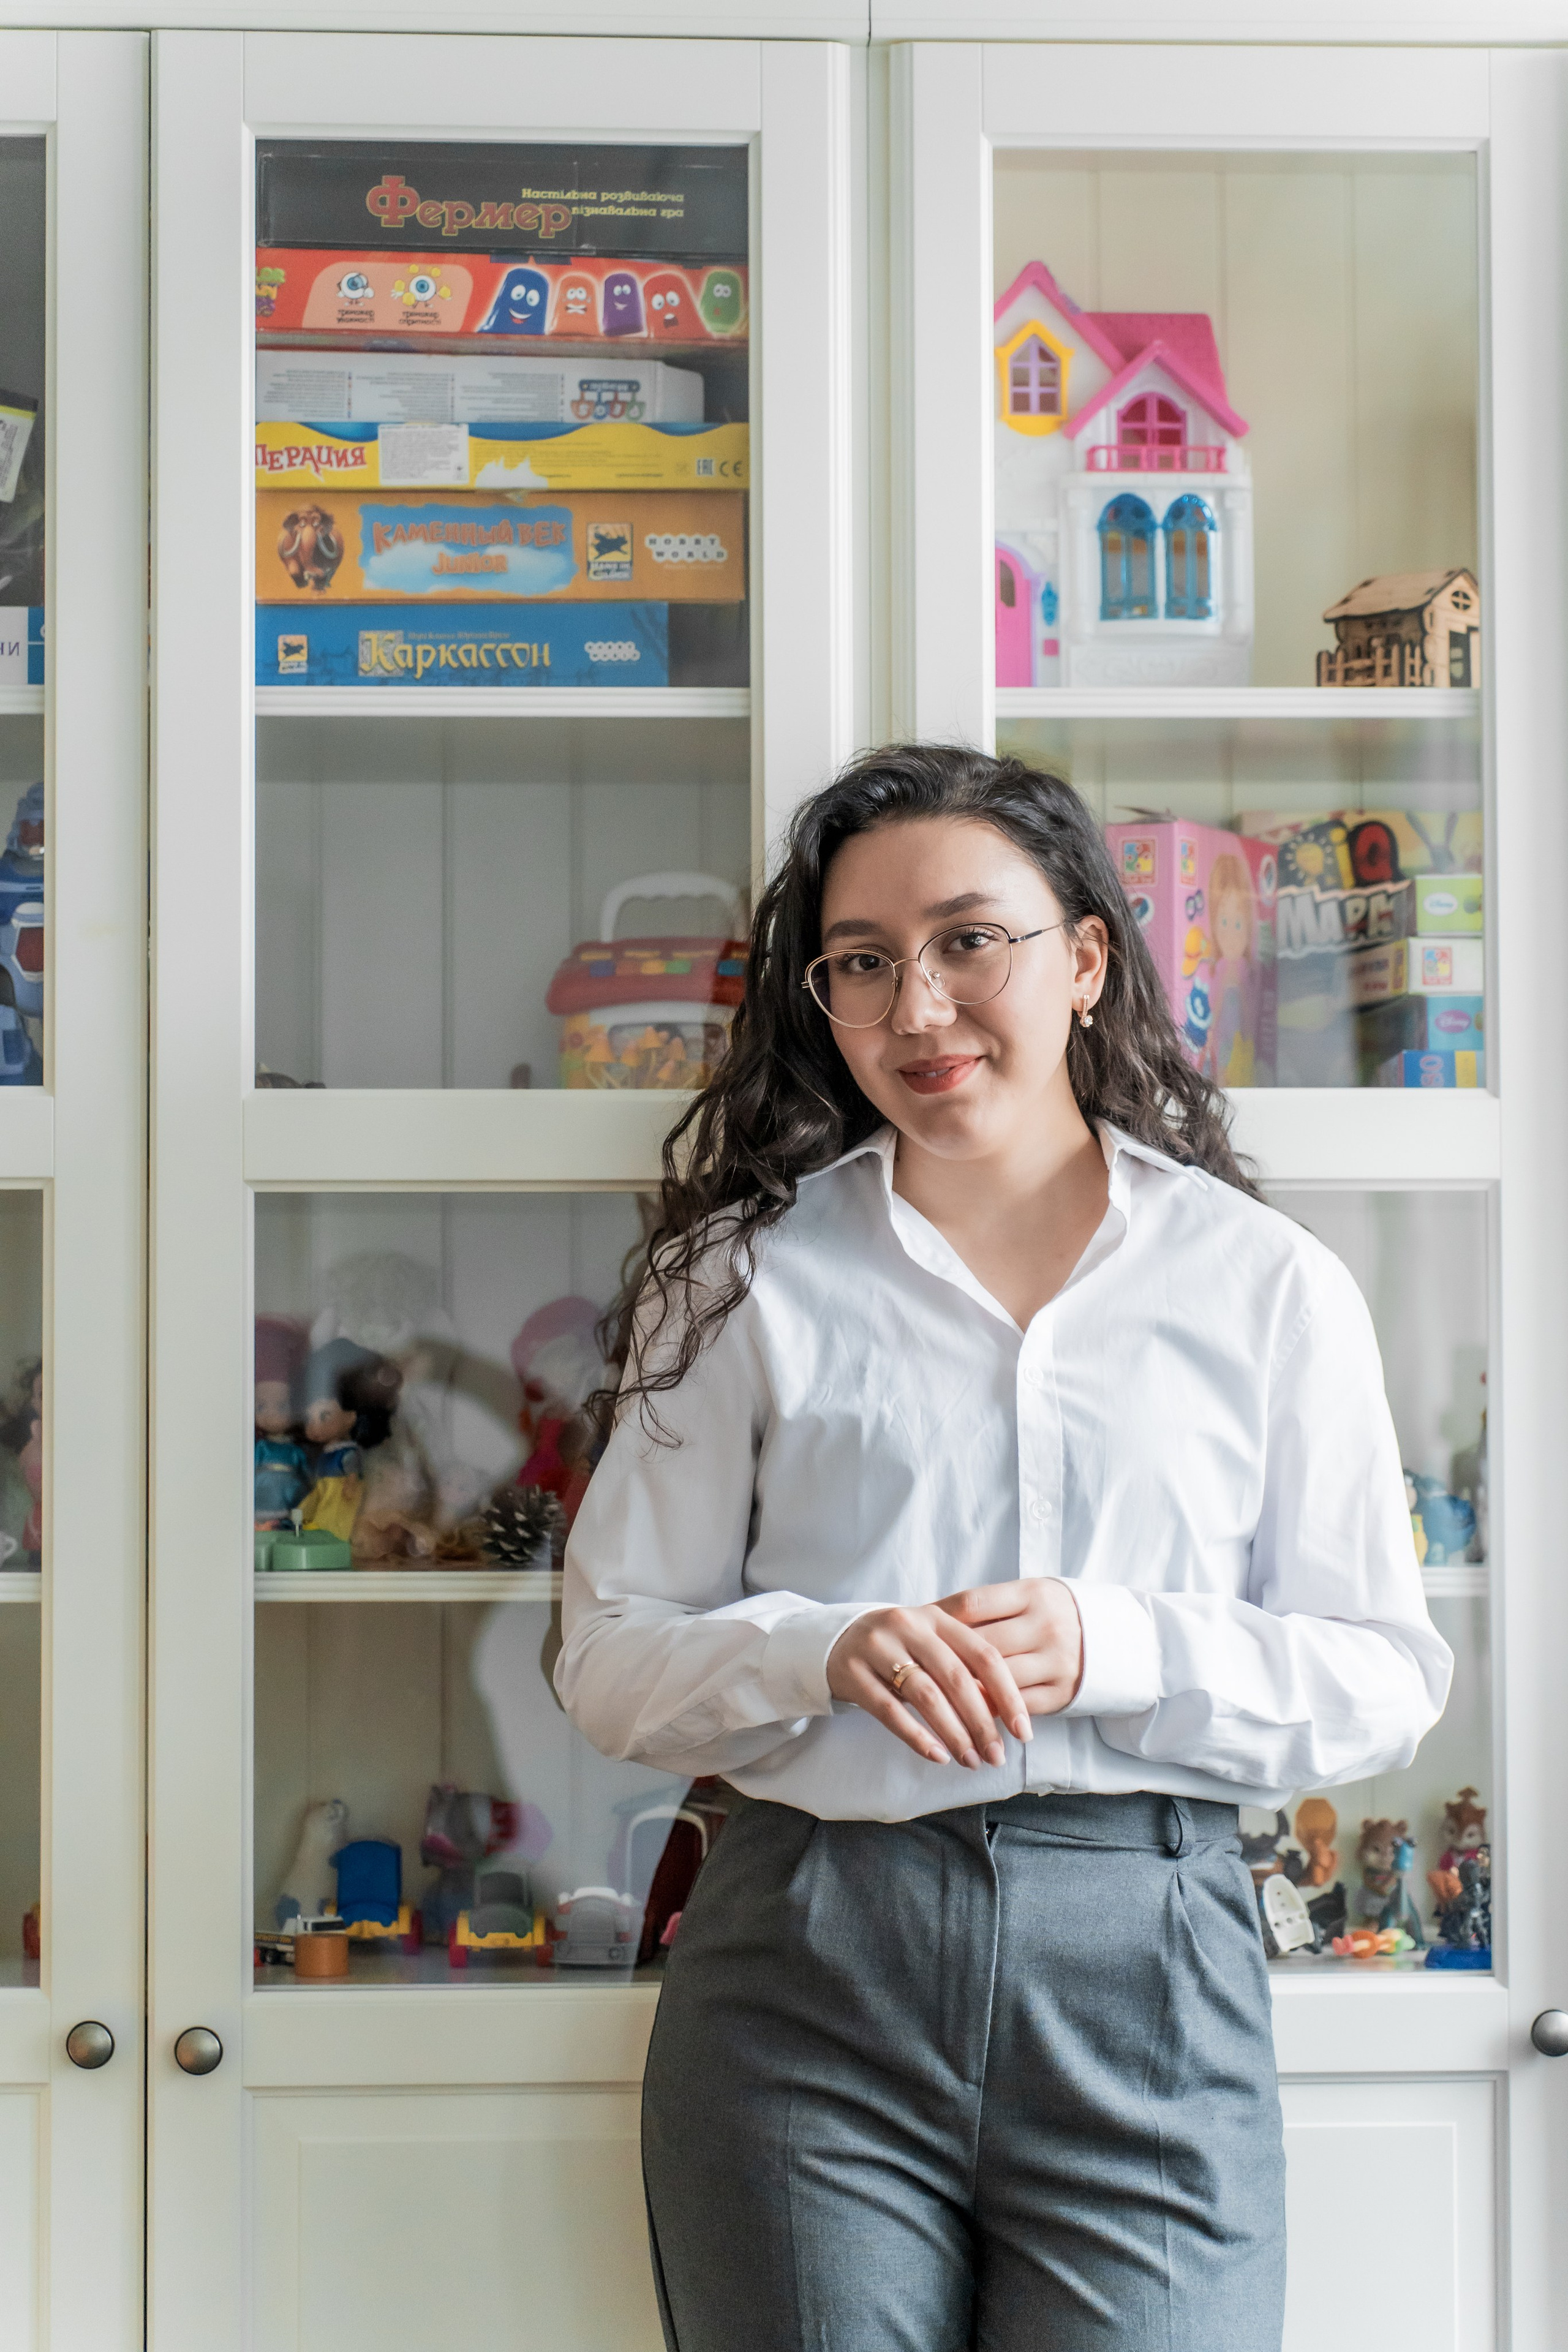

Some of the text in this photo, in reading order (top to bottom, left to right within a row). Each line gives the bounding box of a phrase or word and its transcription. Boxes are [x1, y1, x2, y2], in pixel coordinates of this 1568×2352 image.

[366, 175, 572, 238] Фермер
[522, 188, 684, 203] Настільна розвиваюча
[571, 205, 684, 219] пізнавальна гра
[255, 443, 367, 477] ПЕРАЦИЯ
[372, 519, 567, 555] КАМЕННЫЙ ВЕК
[432, 551, 508, 575] JUNIOR
[361, 633, 551, 680] Каркассон
